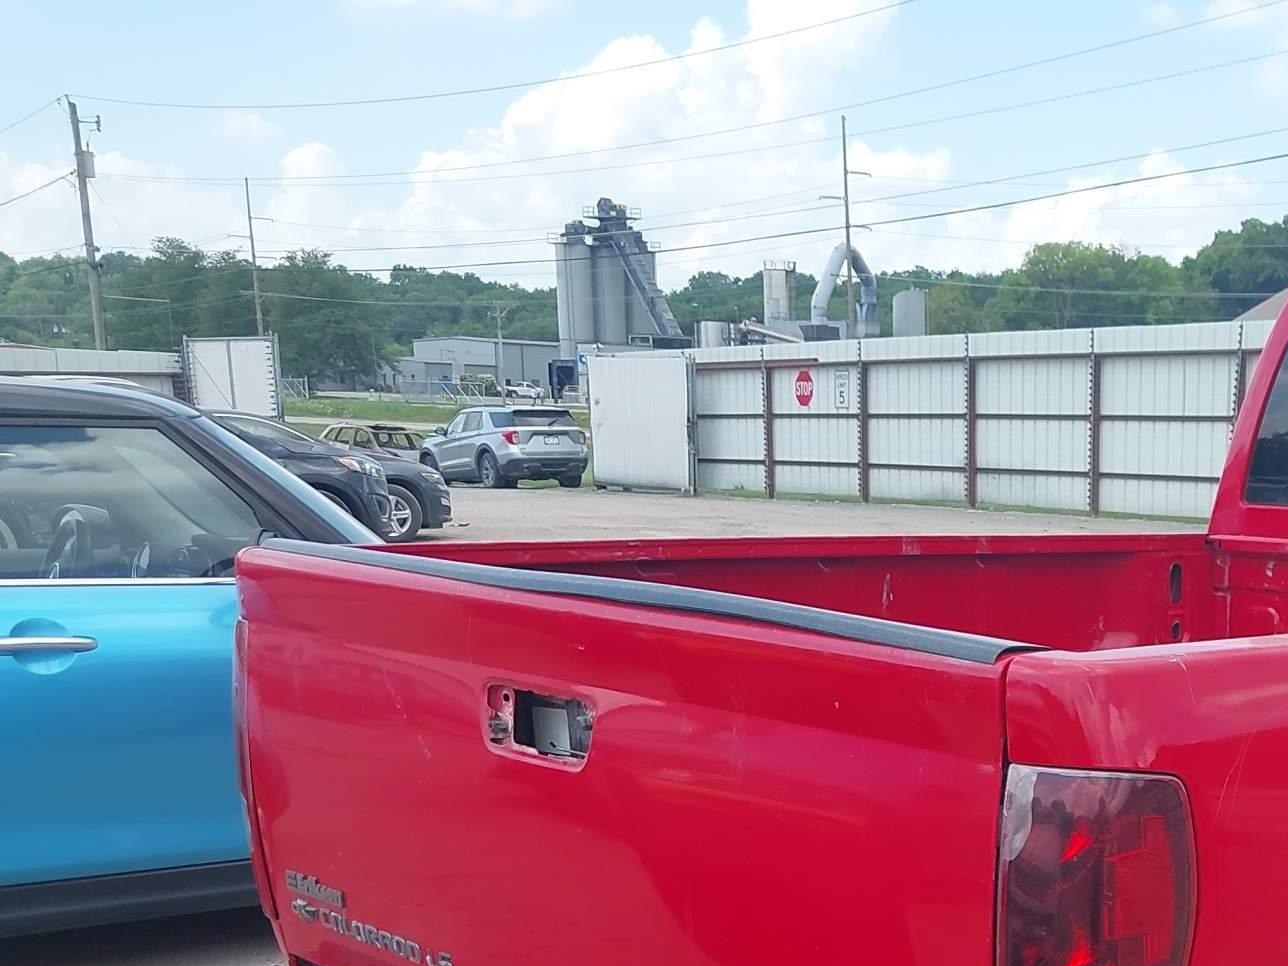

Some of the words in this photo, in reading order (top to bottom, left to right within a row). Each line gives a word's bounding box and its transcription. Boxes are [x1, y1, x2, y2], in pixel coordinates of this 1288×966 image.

[796, 381, 812, 396] STOP
[839, 391, 845, 404] 5
[319, 907, 422, 964] COLORADO
